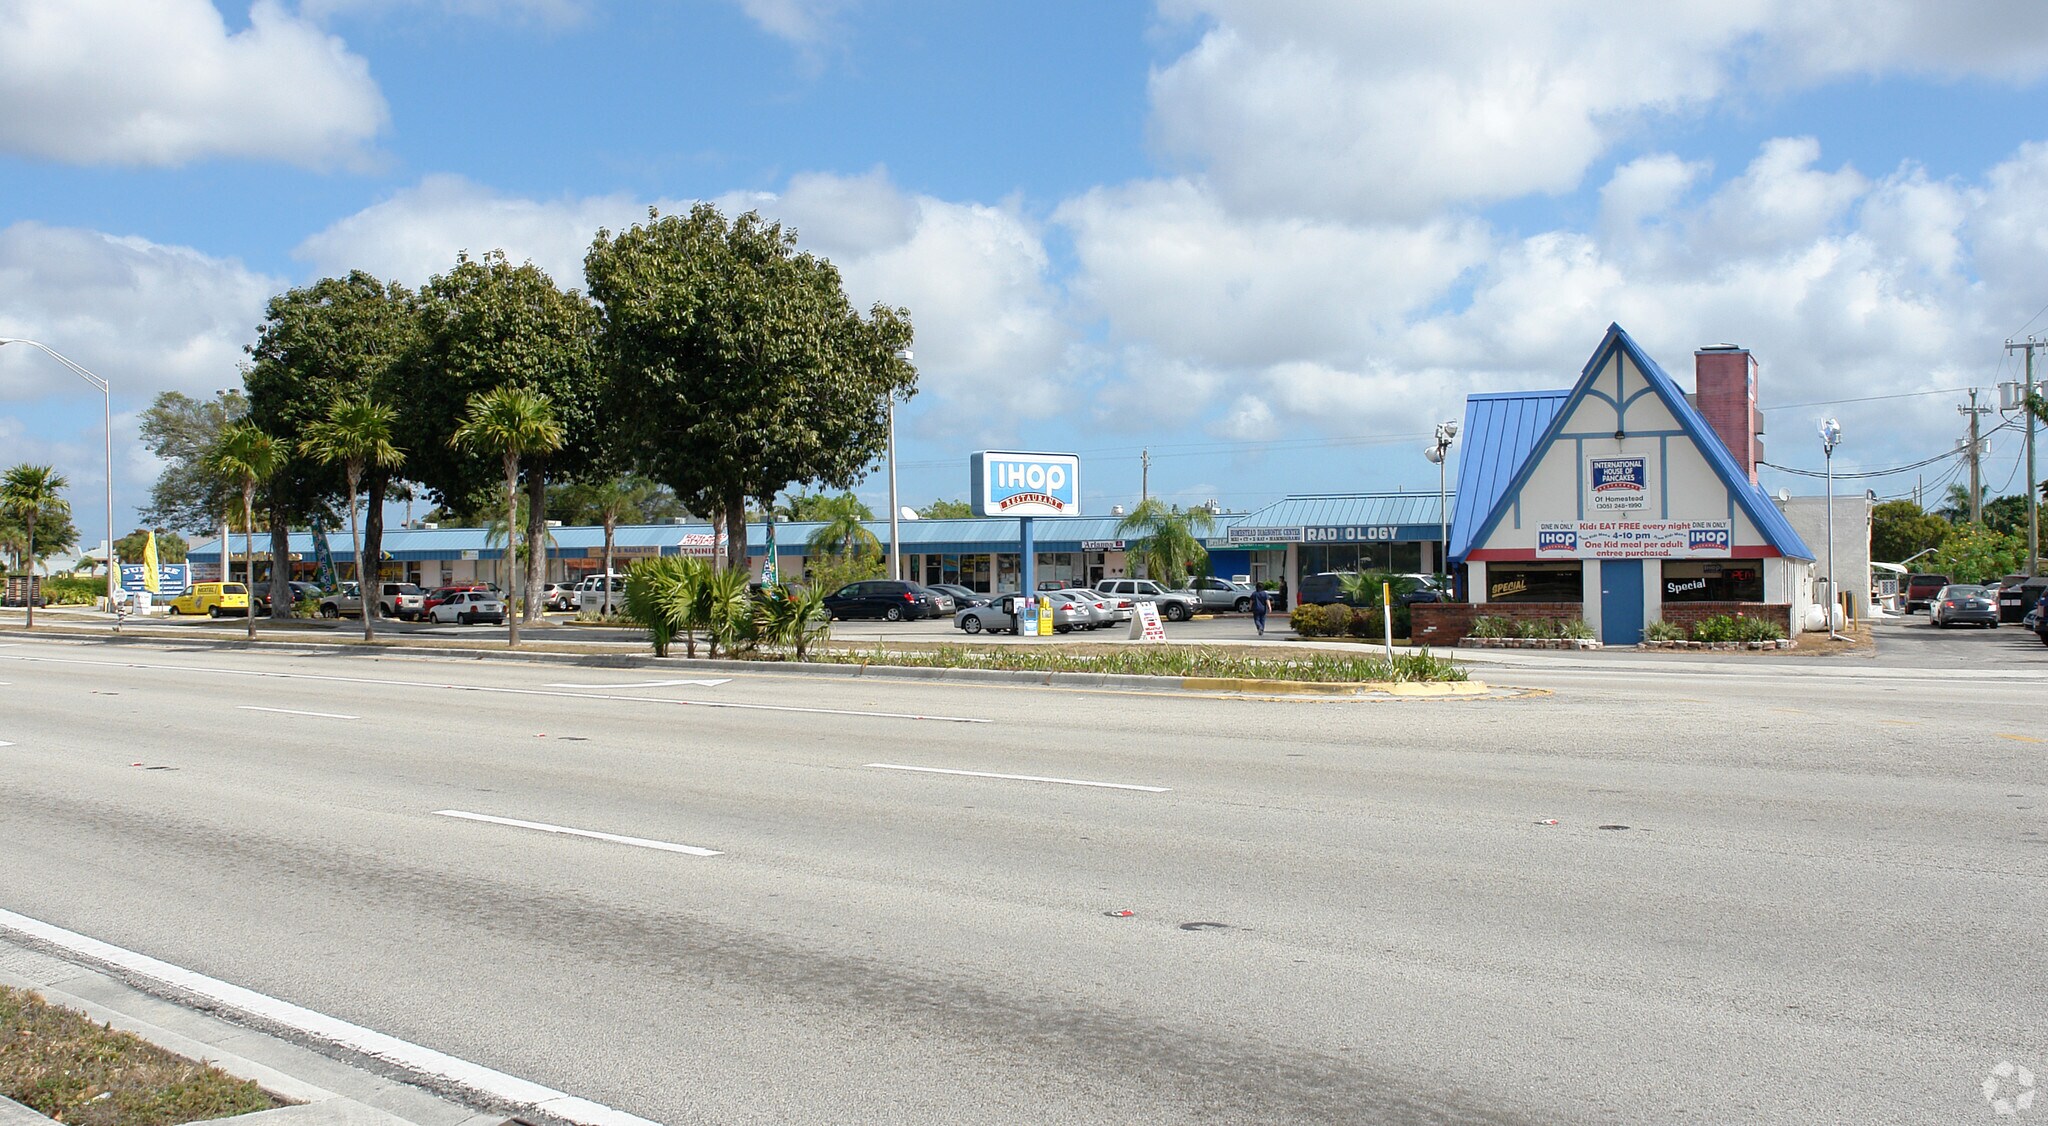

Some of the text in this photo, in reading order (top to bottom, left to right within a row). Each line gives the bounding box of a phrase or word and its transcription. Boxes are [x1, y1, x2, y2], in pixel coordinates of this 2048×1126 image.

[1594, 460, 1643, 469] INTERNATIONAL
[998, 463, 1066, 497] IHOP
[1602, 474, 1635, 482] PANCAKES
[1004, 493, 1060, 509] RESTAURANT
[1599, 522, 1616, 530] EAT
[1618, 522, 1640, 530] FREE
[1642, 523, 1666, 531] every
[1668, 522, 1691, 531] night
[1712, 521, 1727, 529] ONLY
[1307, 527, 1398, 541] RADOLOGY
[1635, 532, 1651, 540] pm
[1690, 531, 1727, 545] IHOP
[1541, 533, 1576, 546] IHOP
[1584, 540, 1684, 550] One Kid meal per adult
[682, 547, 725, 555] TANNIG
[1596, 549, 1672, 558] entree purchased.
[123, 566, 181, 575] JUEE
[1491, 579, 1528, 595] SPECIAL
[1667, 577, 1706, 594] Special
